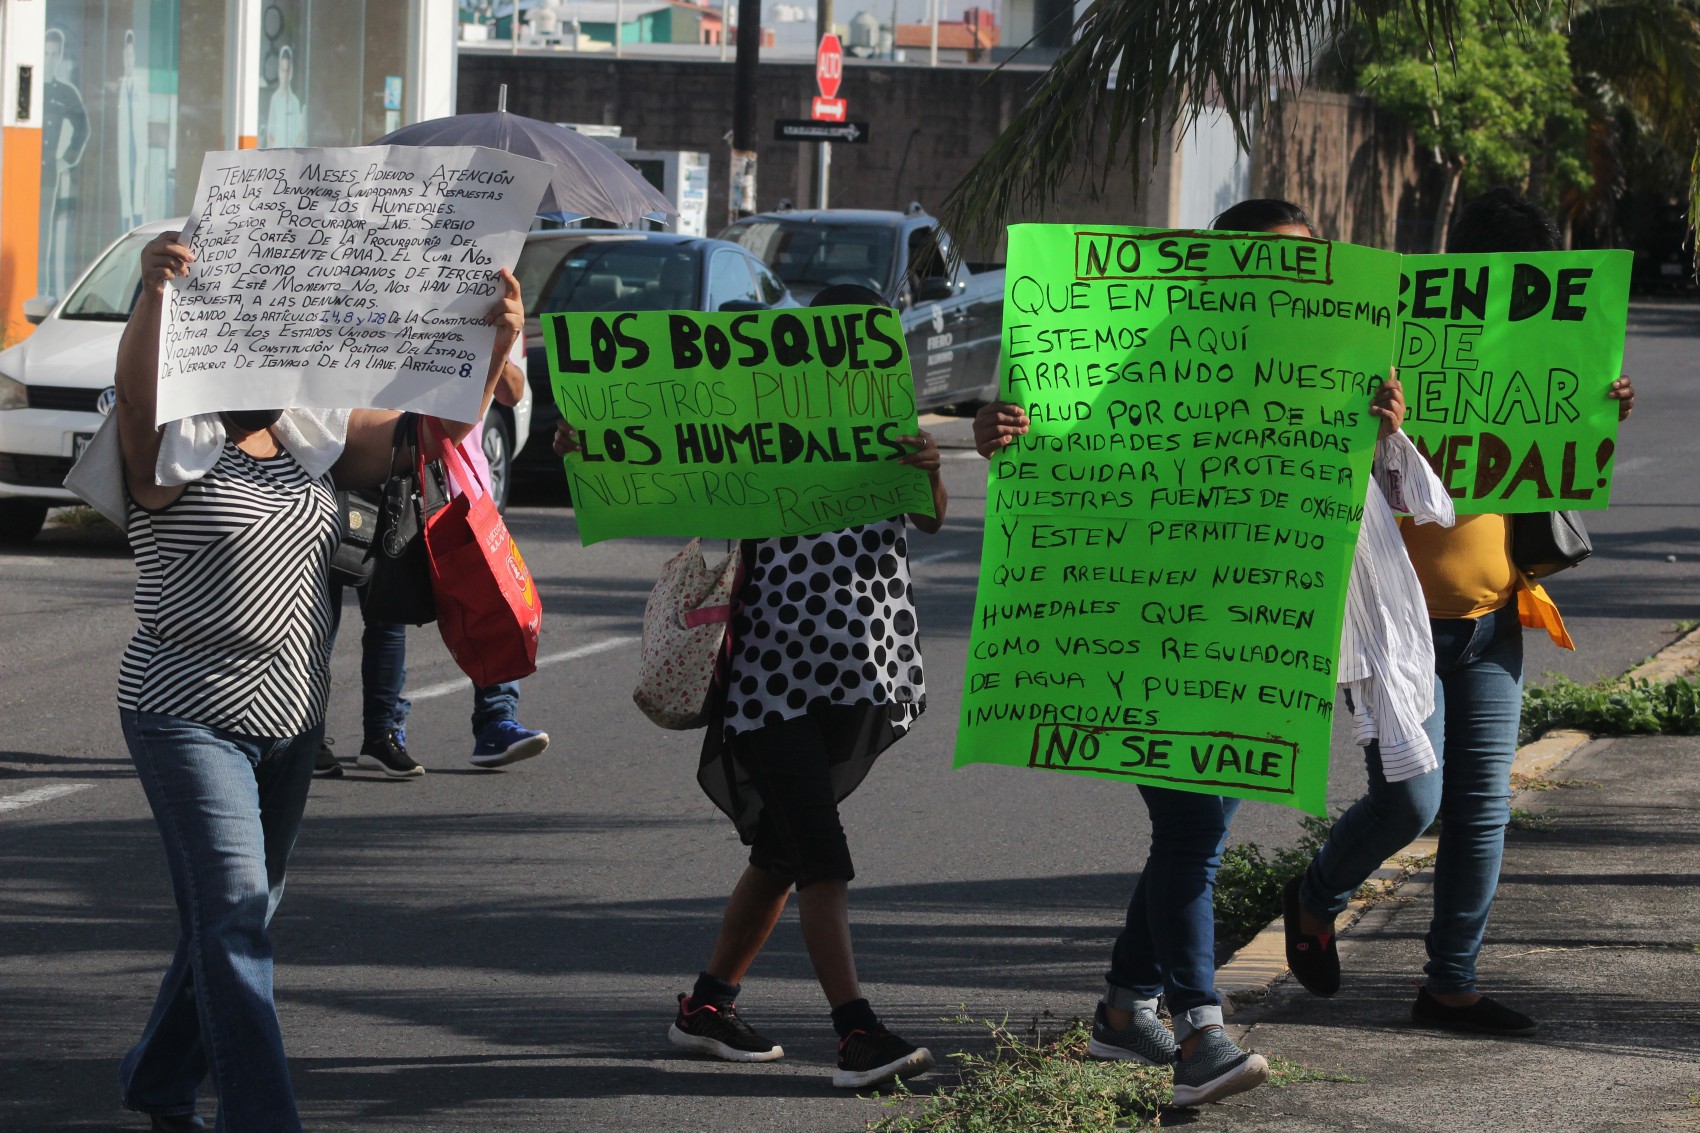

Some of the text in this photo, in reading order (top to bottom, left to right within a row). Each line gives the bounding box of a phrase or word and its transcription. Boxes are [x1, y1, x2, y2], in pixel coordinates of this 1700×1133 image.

[820, 53, 840, 78] ALTO
[217, 163, 514, 185] TENEMOS MESES PIDIENDO ATENCIÓN
[207, 185, 236, 202] PARA
[243, 184, 262, 198] LAS
[273, 179, 341, 198] DENUNCIAS
[419, 181, 431, 197] Y
[436, 181, 503, 200] RESPUESTAS
[201, 202, 212, 218] A
[220, 202, 240, 216] LOS
[249, 198, 285, 211] CASOS
[298, 196, 318, 210] DE
[330, 198, 358, 212] LOS
[225, 215, 266, 232] SEÑOR
[277, 209, 366, 229] PROCURADOR
[421, 214, 474, 230] SERGIO
[248, 228, 296, 243] CORTÉS
[308, 230, 331, 245] DE
[339, 230, 354, 245] LA
[363, 229, 441, 247] PROCURADURÍA
[451, 235, 477, 247] DEL
[192, 249, 237, 263] MEDIO
[248, 243, 327, 260] AMBIENTE
[422, 246, 452, 262] CUAL
[460, 248, 492, 265] NOS
[1086, 235, 1318, 278] NO SE VALE
[200, 263, 241, 278] VISTO
[249, 263, 295, 276] COMO
[307, 265, 395, 278] CIUDADANOS
[405, 267, 430, 279] DE
[437, 266, 500, 282] TERCERA
[272, 276, 341, 292] MOMENTO
[385, 280, 410, 293] NOS
[420, 280, 450, 293] HAN
[456, 282, 497, 296] DADO
[253, 295, 262, 306] A
[269, 296, 296, 307] LAS
[1011, 275, 1391, 329] QUE EN PLENA PANDEMIA
[1508, 263, 1593, 322] DE
[170, 307, 226, 322] VIOLANDO
[233, 304, 258, 321] LOS
[367, 311, 387, 324] 128
[387, 311, 401, 324] DE
[404, 309, 419, 323] LA
[217, 322, 238, 337] DE
[245, 324, 270, 338] LOS
[279, 323, 332, 338] ESTADOS
[338, 326, 386, 339] UNIDOS
[552, 307, 903, 374] LOS BOSQUES
[1009, 324, 1249, 358] ESTEMOS AQUÍ
[1398, 321, 1484, 370] DE
[165, 343, 218, 361] VIOLANDO
[224, 339, 239, 353] LA
[397, 341, 419, 355] DEL
[424, 340, 476, 361] ESTADO
[161, 363, 173, 380] DE
[179, 358, 226, 374] VERACRUZ
[234, 355, 254, 368] DE
[259, 354, 309, 369] IGNACIO
[317, 354, 339, 368] DE
[344, 354, 361, 368] LA
[401, 356, 456, 375] ARTÍCULO
[1008, 358, 1384, 396] ARRIESGANDO NUESTRA
[560, 380, 737, 421] NUESTROS
[752, 370, 915, 421] PULMONES
[1014, 399, 1359, 429] ALUD POR CULPA DE LAS
[578, 422, 907, 466] LOS HUMEDALES
[1193, 427, 1352, 454] ENCARGADAS
[997, 455, 1353, 489] DE CUIDAR Y PROTEGER
[573, 471, 931, 527] NUESTROS RIÑONES
[996, 486, 1364, 524] NUESTRAS FUENTES DE OXÍGENO
[1001, 515, 1324, 558] Y ESTEN PERMITIENDO
[993, 565, 1325, 589] QUE RRELLENEN NUESTROS
[982, 599, 1315, 630] HUMEDALES QUE SIRVEN
[974, 636, 1332, 676] COMO VASOS REGULADORES
[969, 670, 1333, 722] DE AGUA Y PUEDEN EVITAR
[1045, 725, 1282, 777] NO SE VALE
